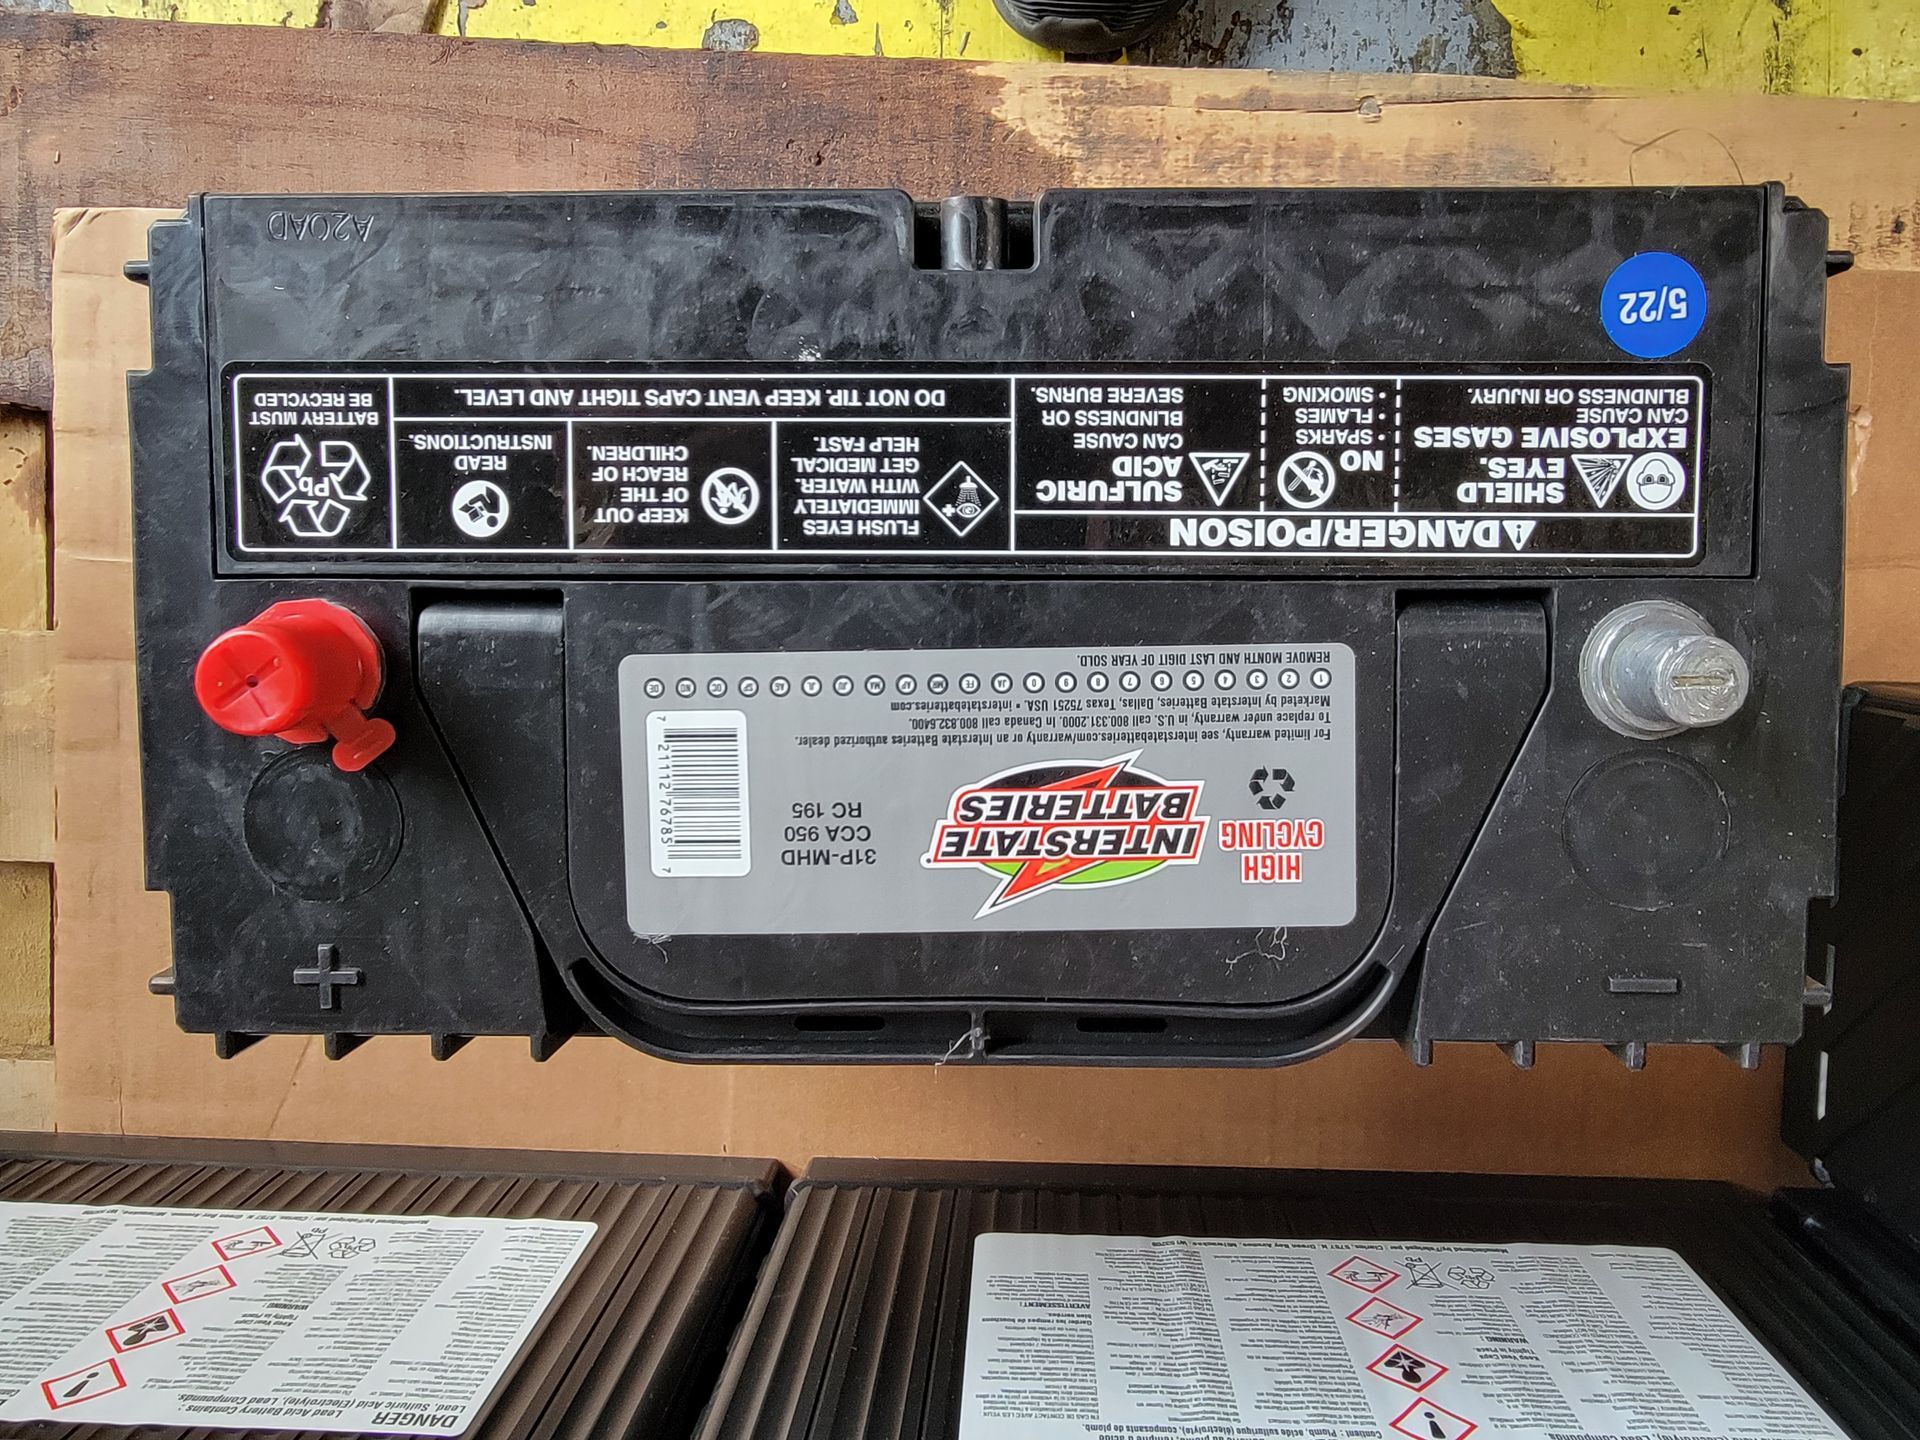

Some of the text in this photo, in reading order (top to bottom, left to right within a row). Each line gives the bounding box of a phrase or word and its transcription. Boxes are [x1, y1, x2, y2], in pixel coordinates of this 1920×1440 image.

[1619, 286, 1688, 324] 5/22
[255, 393, 373, 407] BE RECYCLED
[455, 390, 945, 407] DO NOT TIP. KEEP VENT CAPS TIGHT AND LEVEL.
[1032, 388, 1184, 404] SEVERE BURNS.
[1284, 387, 1374, 403] SMOKING
[1468, 389, 1689, 405] BLINDNESS OR INJURY.
[250, 412, 379, 426] BATTERY MUST
[1043, 411, 1183, 426] BLINDNESS OR
[1296, 408, 1373, 424] FLAMES
[1577, 408, 1689, 424] CAN CAUSE
[409, 435, 552, 450] INSTRUCTIONS.
[814, 437, 919, 453] HELP FAST.
[1074, 433, 1183, 449] CAN CAUSE
[1296, 429, 1373, 445] SPARKS
[1415, 426, 1687, 449] EXPLOSIVE GASES
[587, 446, 689, 462] CHILDREN.
[1340, 450, 1383, 472] NO
[455, 456, 507, 471] READ
[791, 458, 920, 473] GET MEDICAL
[1113, 456, 1183, 478] ACID
[1480, 458, 1565, 479] EYES.
[592, 467, 688, 482] REACH OF
[299, 476, 329, 496] Pb
[796, 479, 920, 494] WITH WATER.
[1037, 481, 1183, 502] SULFURIC
[1457, 483, 1565, 504] SHIELD
[621, 488, 689, 503] OF THE
[594, 508, 689, 523] KEEP OUT
[794, 500, 920, 515] IMMEDIATELY
[804, 520, 919, 536] FLUSH EYES
[1168, 518, 1500, 549] DANGER/POISON
[1078, 652, 1330, 667] REMOVE MONTH AND LAST DIGIT OF YEAR SOLD.
[891, 694, 1331, 713] Marketed by Interstate Batteries, Dallas, Texas 75251 USA. interstatebatteries.com
[909, 710, 1332, 730] To replace under warranty, in U.S. call 800.331.2000. In Canada call 800.832.6400.
[796, 728, 1331, 748] For limited warranty, see interstatebatteries.com/warranty or an Interstate Batteries authorized dealer.
[793, 803, 862, 819] RC 195
[958, 792, 1190, 823] BATTERIES
[785, 826, 871, 842] CCA 950
[941, 827, 1198, 857] INTERSTATE
[1222, 820, 1323, 849] CYCLING
[782, 849, 877, 866] 31P-MHD
[1243, 854, 1301, 881] HIGH
[248, 1397, 279, 1406] Lead
[356, 1400, 384, 1410] Acid
[385, 1402, 430, 1412] Sulfuric
[435, 1403, 466, 1414] Lead,
[284, 1408, 311, 1417] Acid
[312, 1409, 343, 1418] Lead
[371, 1412, 458, 1428] DANGER
[1083, 1424, 1112, 1433] plomb.
[1114, 1425, 1124, 1433] de
[1281, 1429, 1304, 1438] acide
[1306, 1429, 1338, 1438] Plomb,
